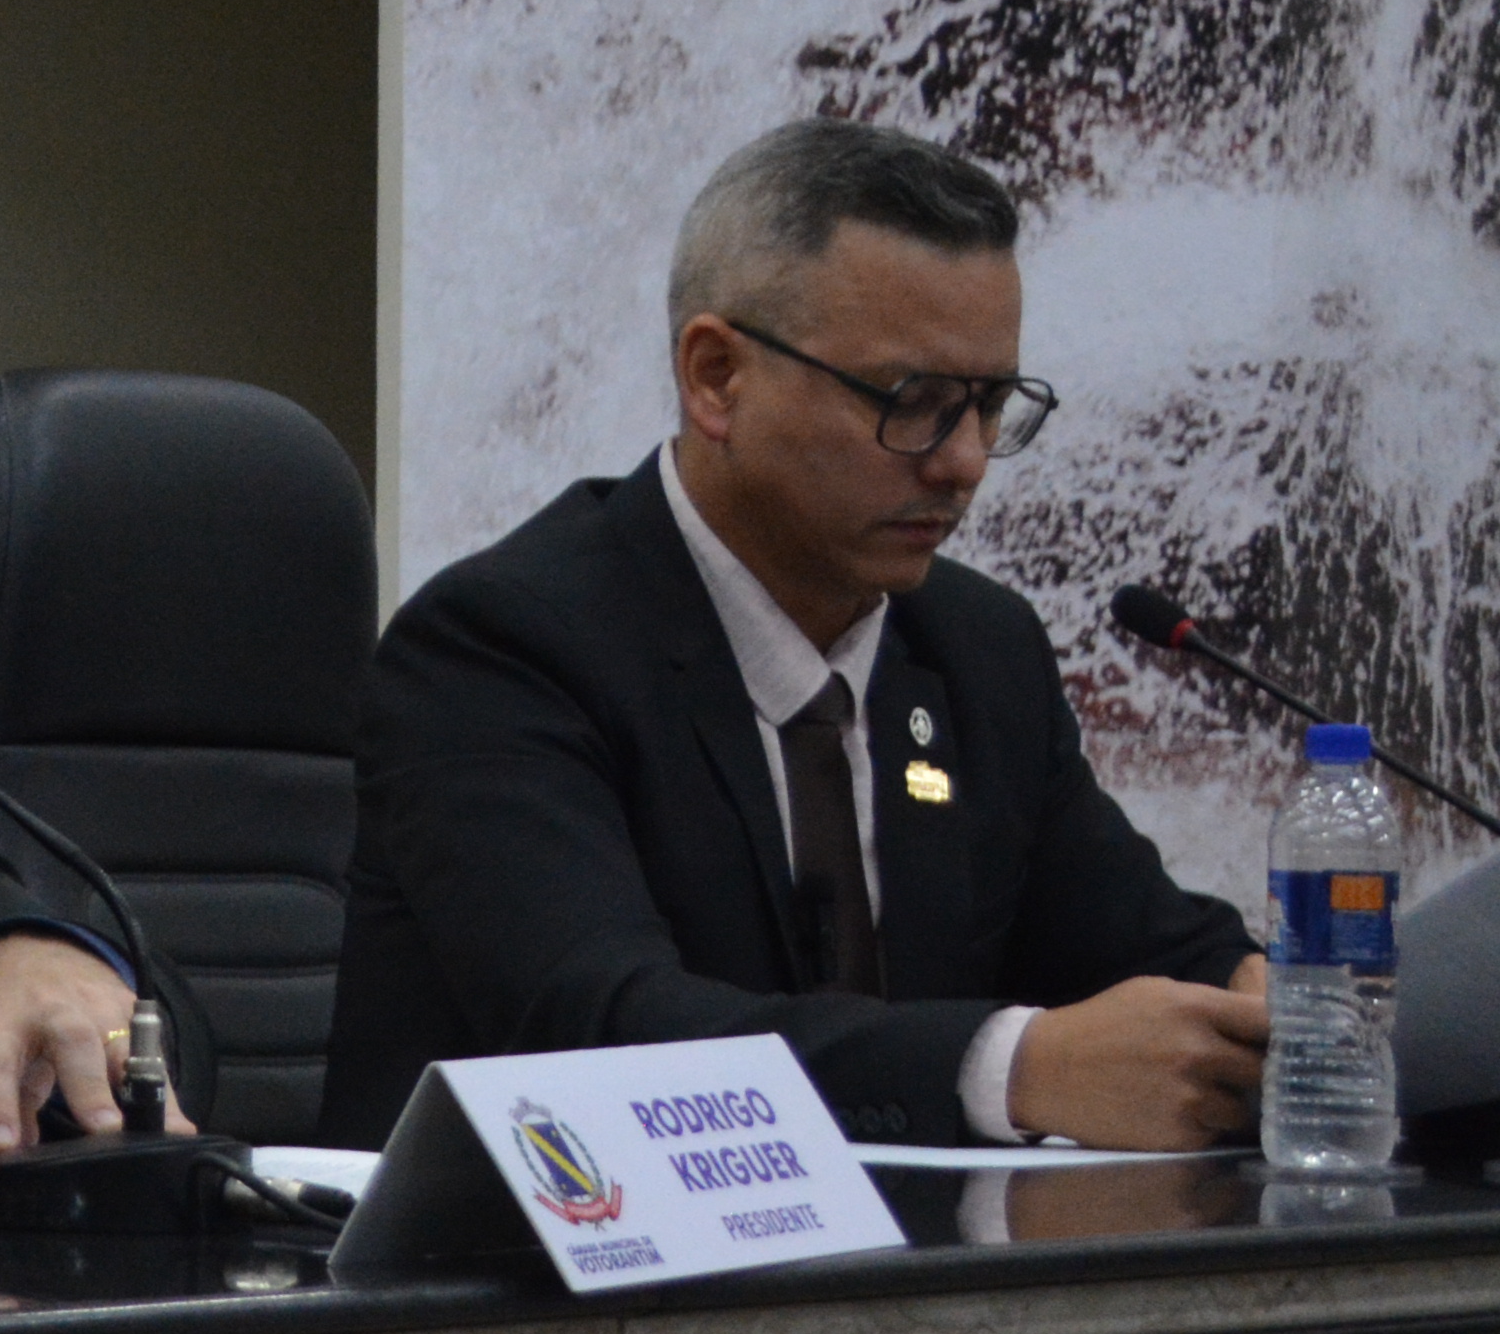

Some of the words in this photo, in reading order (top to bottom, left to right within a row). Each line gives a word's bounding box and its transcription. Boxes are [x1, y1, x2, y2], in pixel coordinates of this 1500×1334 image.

[629, 1087, 776, 1139] RODRIGO
[668, 1140, 809, 1192] KRIGUER
[720, 1203, 824, 1241] PRESIDENTE
[572, 1246, 665, 1274] VOTORANTIM
